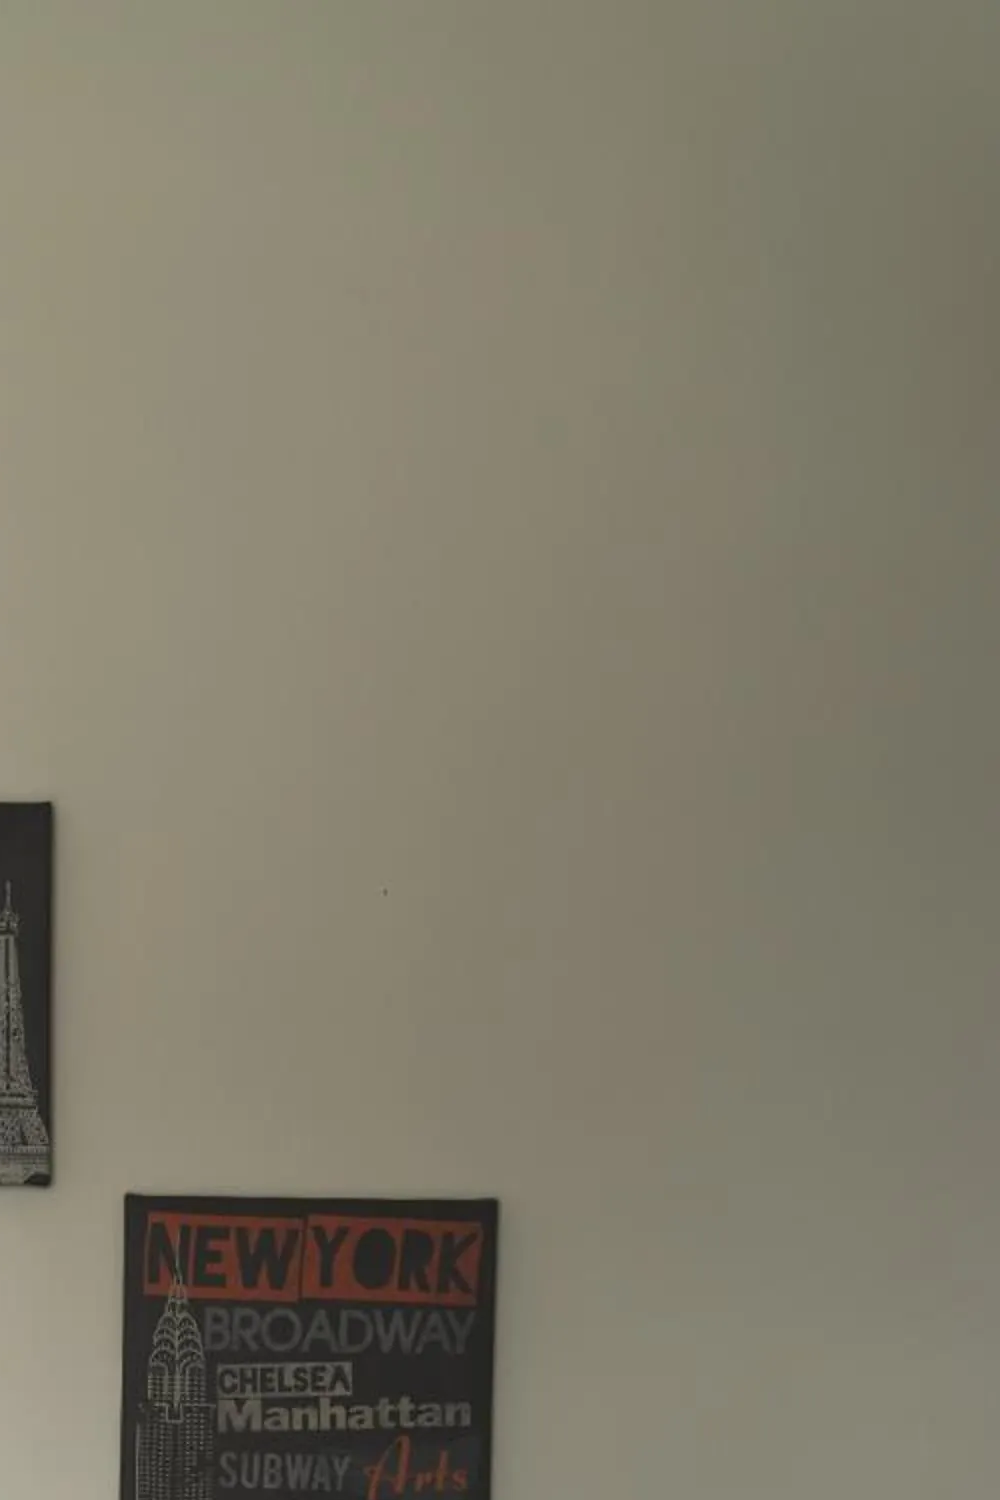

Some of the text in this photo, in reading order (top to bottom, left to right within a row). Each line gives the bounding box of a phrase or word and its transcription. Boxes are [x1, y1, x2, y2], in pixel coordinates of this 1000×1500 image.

[148, 1222, 477, 1295] NEW YORK
[204, 1306, 476, 1354] BROADWAY
[219, 1366, 351, 1395] CHELSEA
[218, 1395, 472, 1433] Manhattan
[218, 1452, 352, 1491] SUBWAY
